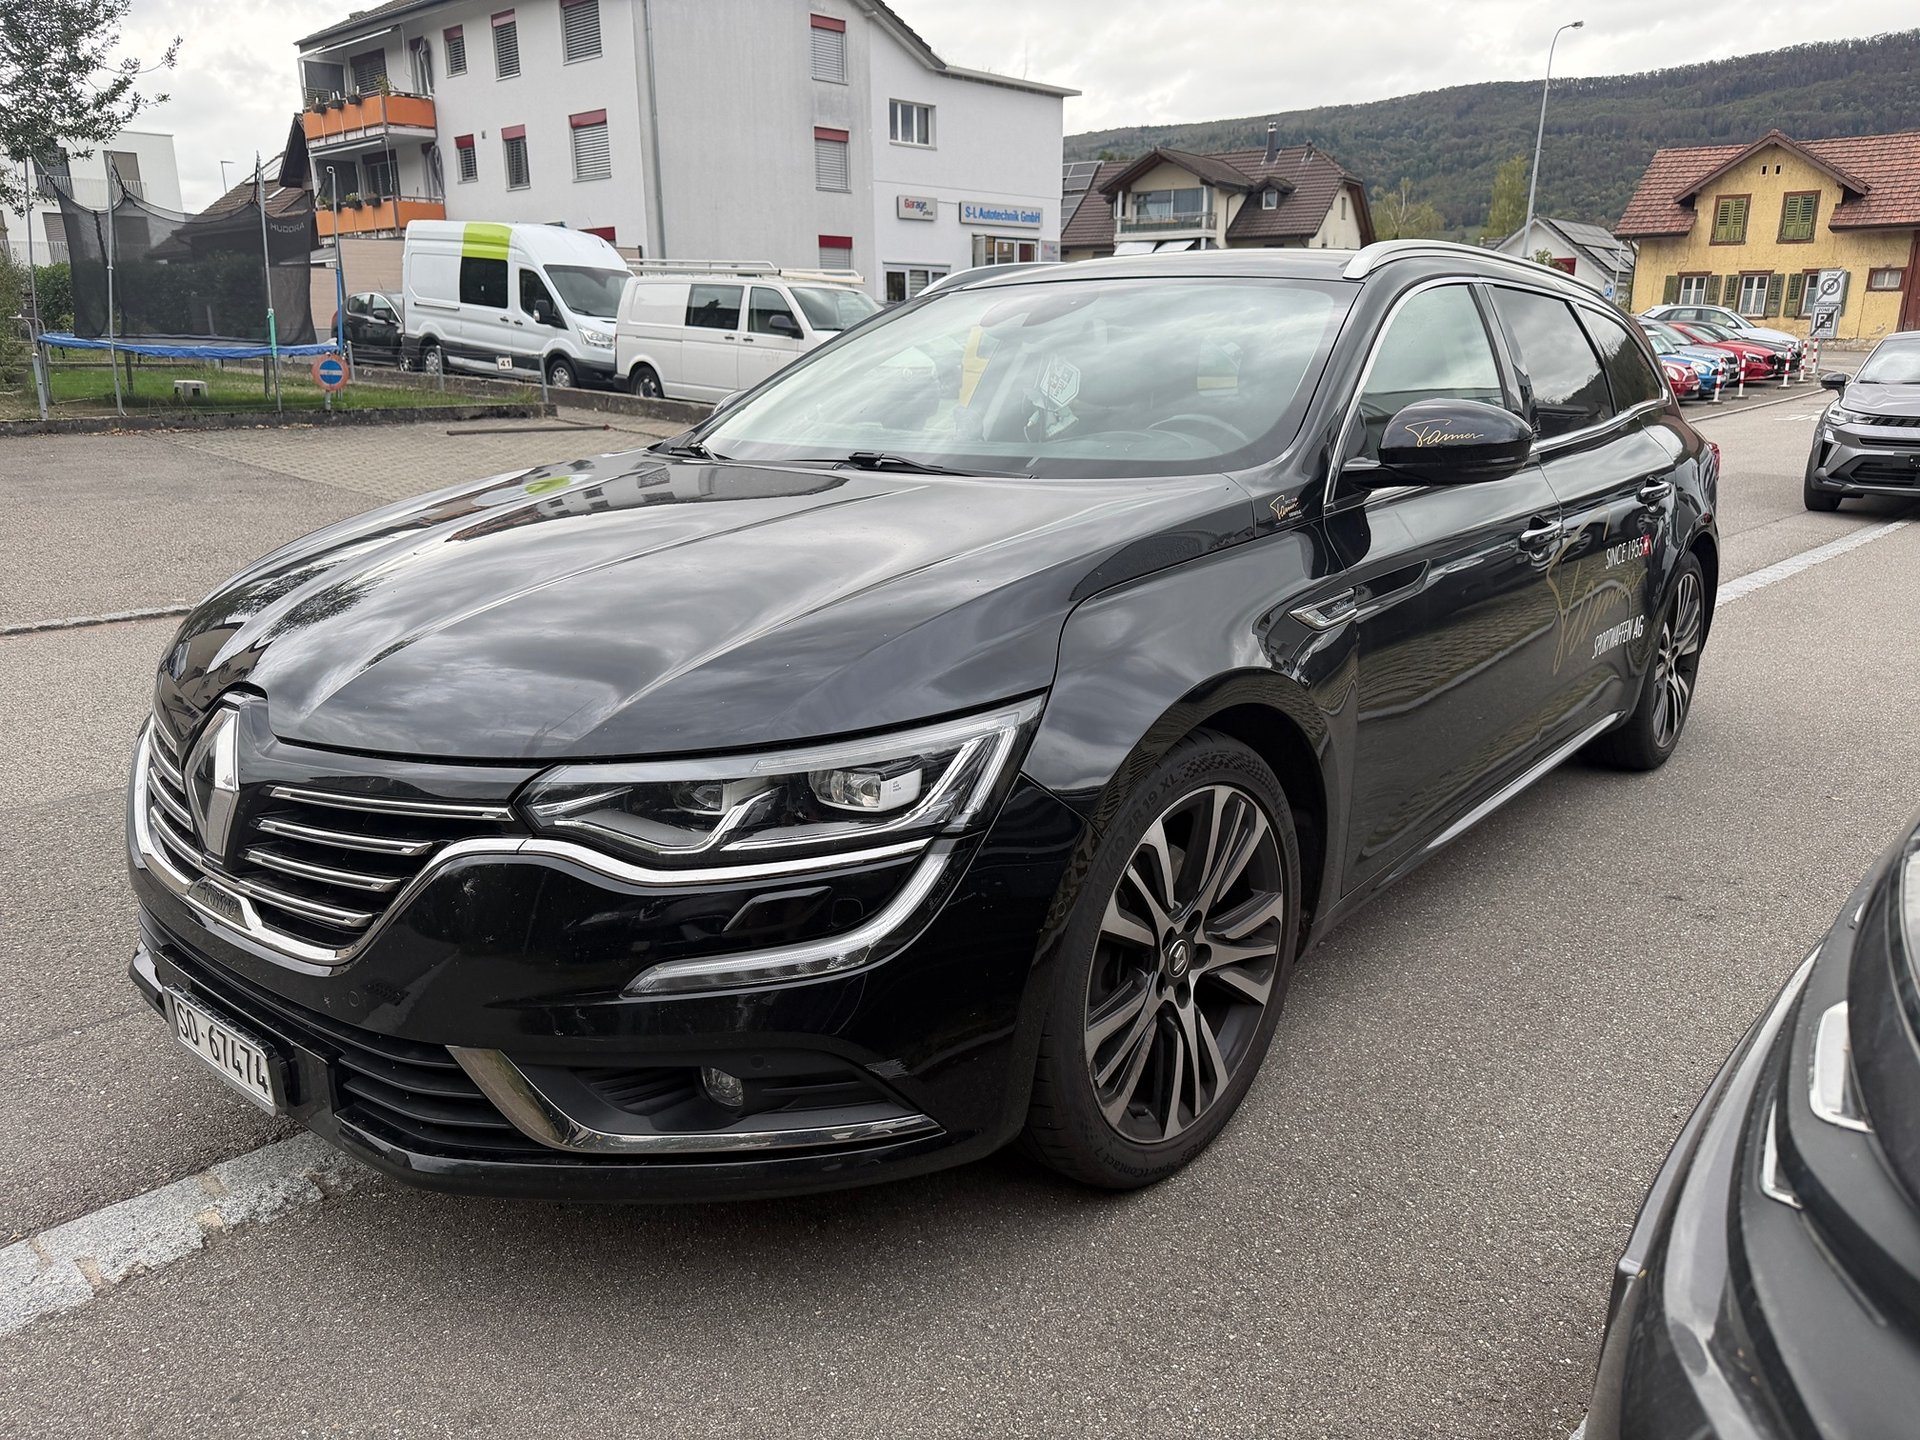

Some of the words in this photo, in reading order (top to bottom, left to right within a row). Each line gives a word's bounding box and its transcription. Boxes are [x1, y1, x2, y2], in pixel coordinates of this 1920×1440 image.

[904, 198, 927, 213] Garage
[965, 207, 977, 220] S-L
[979, 208, 1019, 222] Autotechnik
[1021, 212, 1041, 224] GmbH
[1605, 543, 1627, 570] SINCE
[1627, 536, 1644, 560] 1955
[1632, 614, 1645, 640] AG
